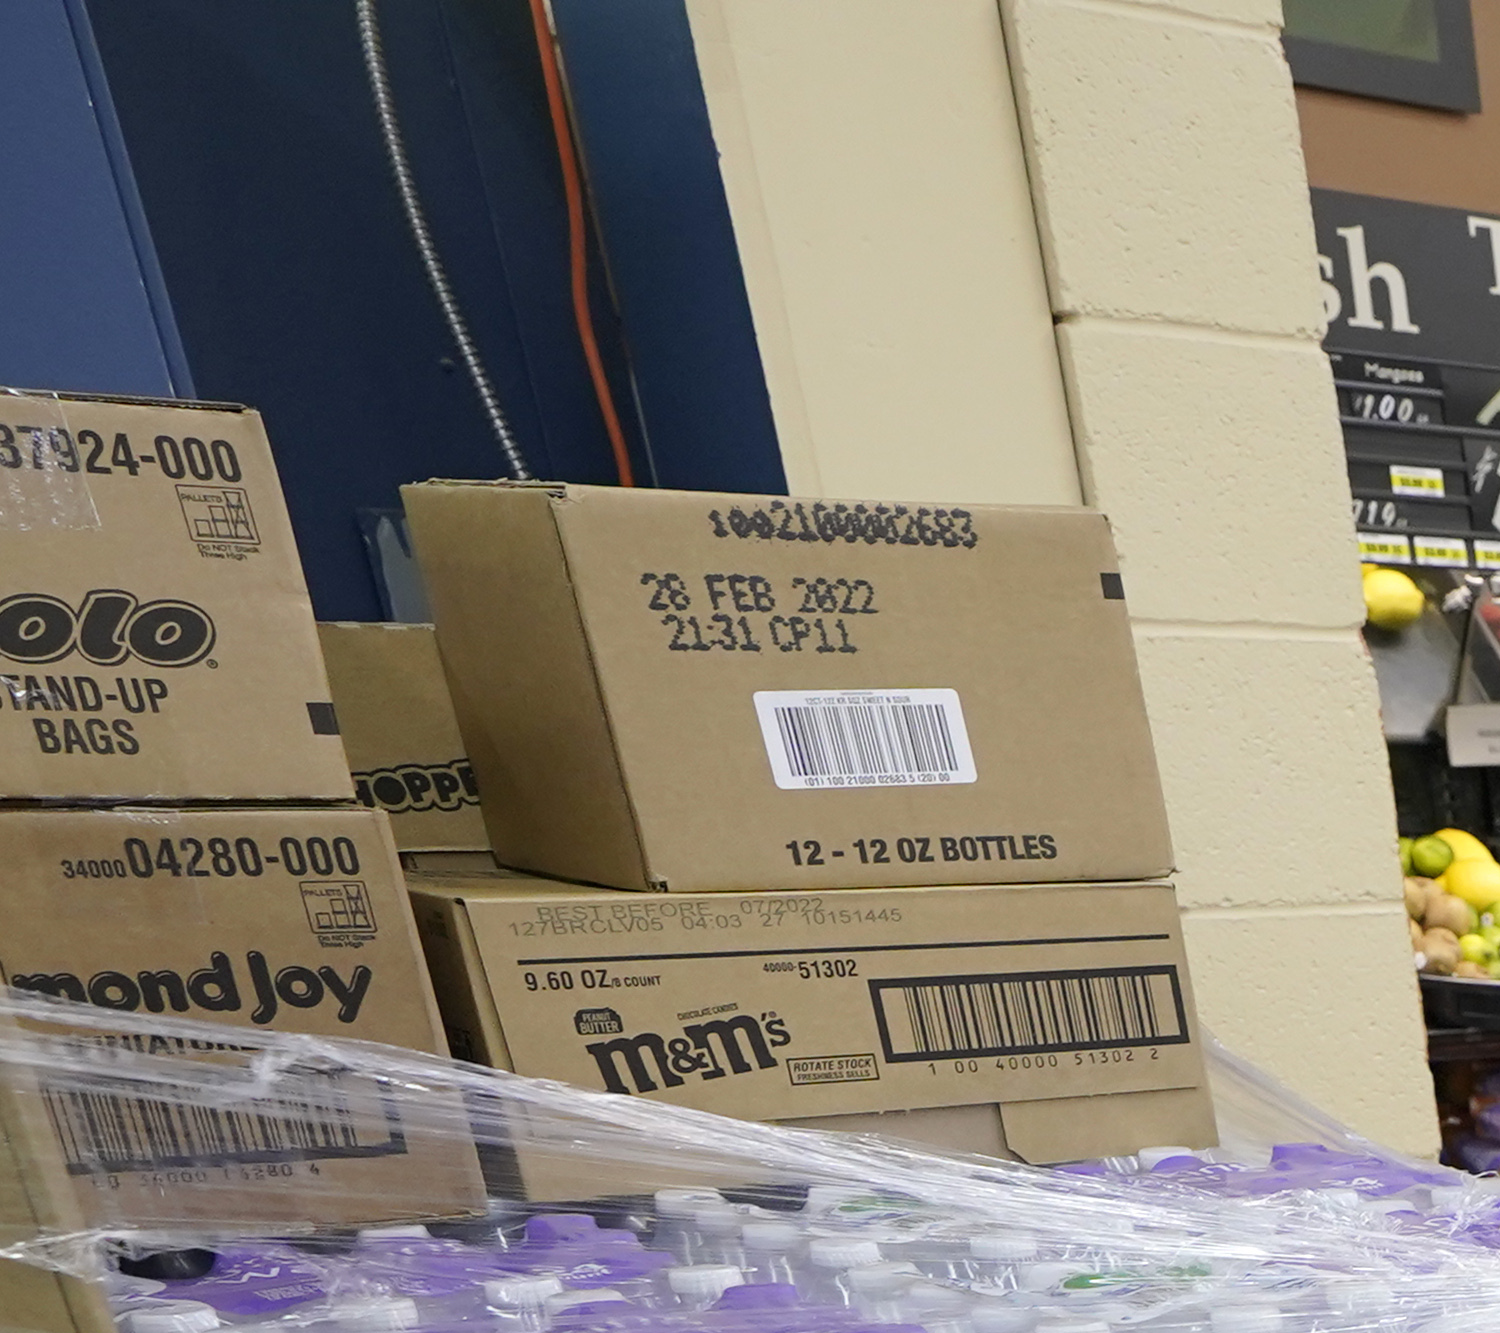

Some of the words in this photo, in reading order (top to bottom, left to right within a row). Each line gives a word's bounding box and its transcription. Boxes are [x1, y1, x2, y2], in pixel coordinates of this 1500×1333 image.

[704, 574, 775, 612] FEB
[792, 577, 880, 614] 2022
[33, 717, 140, 755] BAGS
[61, 858, 127, 879] 34000
[124, 836, 360, 878] 04280-000
[785, 841, 824, 866] 12
[853, 838, 890, 864] 12
[898, 837, 935, 863] OZ
[941, 834, 1058, 862] BOTTLES
[537, 902, 600, 922] BEST
[610, 901, 711, 920] BEFORE
[740, 896, 825, 915] 07/2022
[762, 910, 785, 928] 27
[524, 971, 575, 992] 9.60
[624, 974, 662, 989] COUNT
[579, 1020, 620, 1036] BUTTER
[580, 1010, 612, 1023] PEANUT
[792, 1059, 833, 1074] ROTATE
[834, 1056, 872, 1072] STOCK
[928, 1063, 936, 1076] 1
[954, 1059, 979, 1074] 00
[995, 1054, 1059, 1072] 40000
[1074, 1049, 1135, 1066] 51302
[1150, 1047, 1160, 1061] 2
